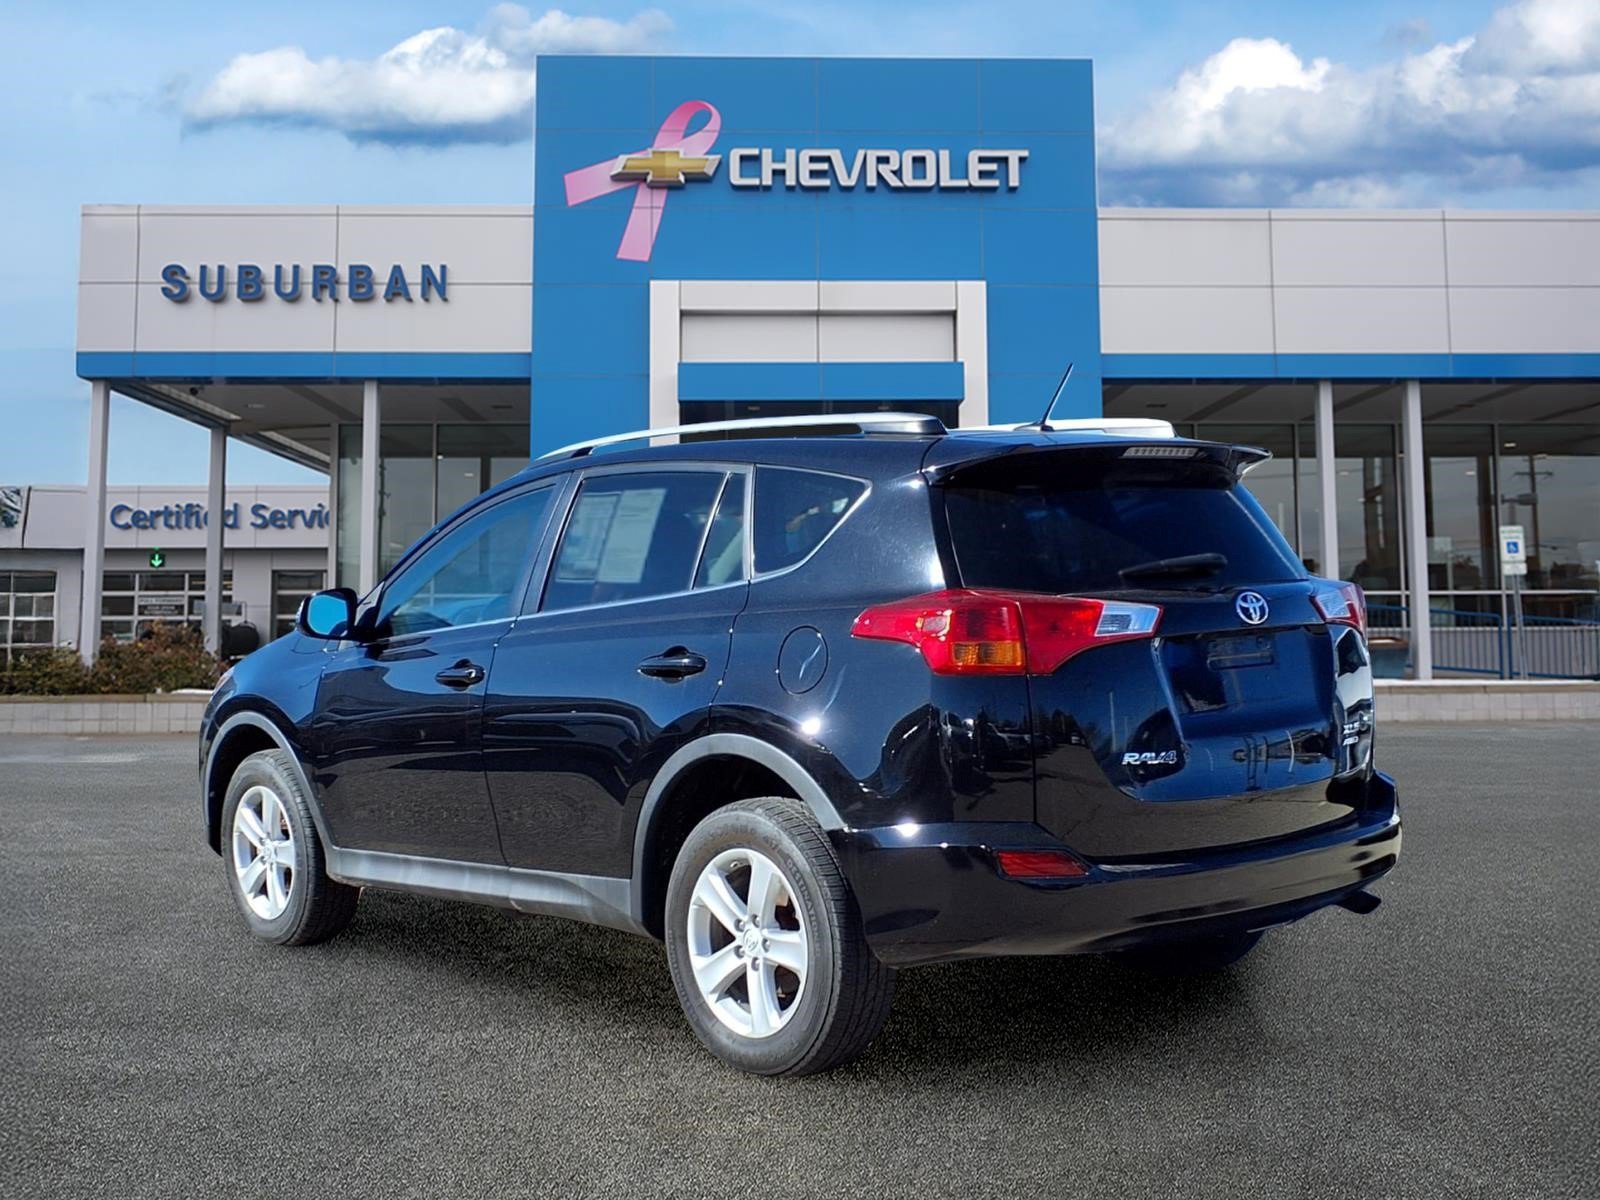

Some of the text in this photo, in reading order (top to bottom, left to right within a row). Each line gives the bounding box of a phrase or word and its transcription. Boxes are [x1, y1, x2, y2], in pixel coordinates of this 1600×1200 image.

[729, 148, 1029, 188] CHEVROLET
[160, 264, 449, 302] SUBURBAN
[1121, 750, 1178, 765] RAV4
